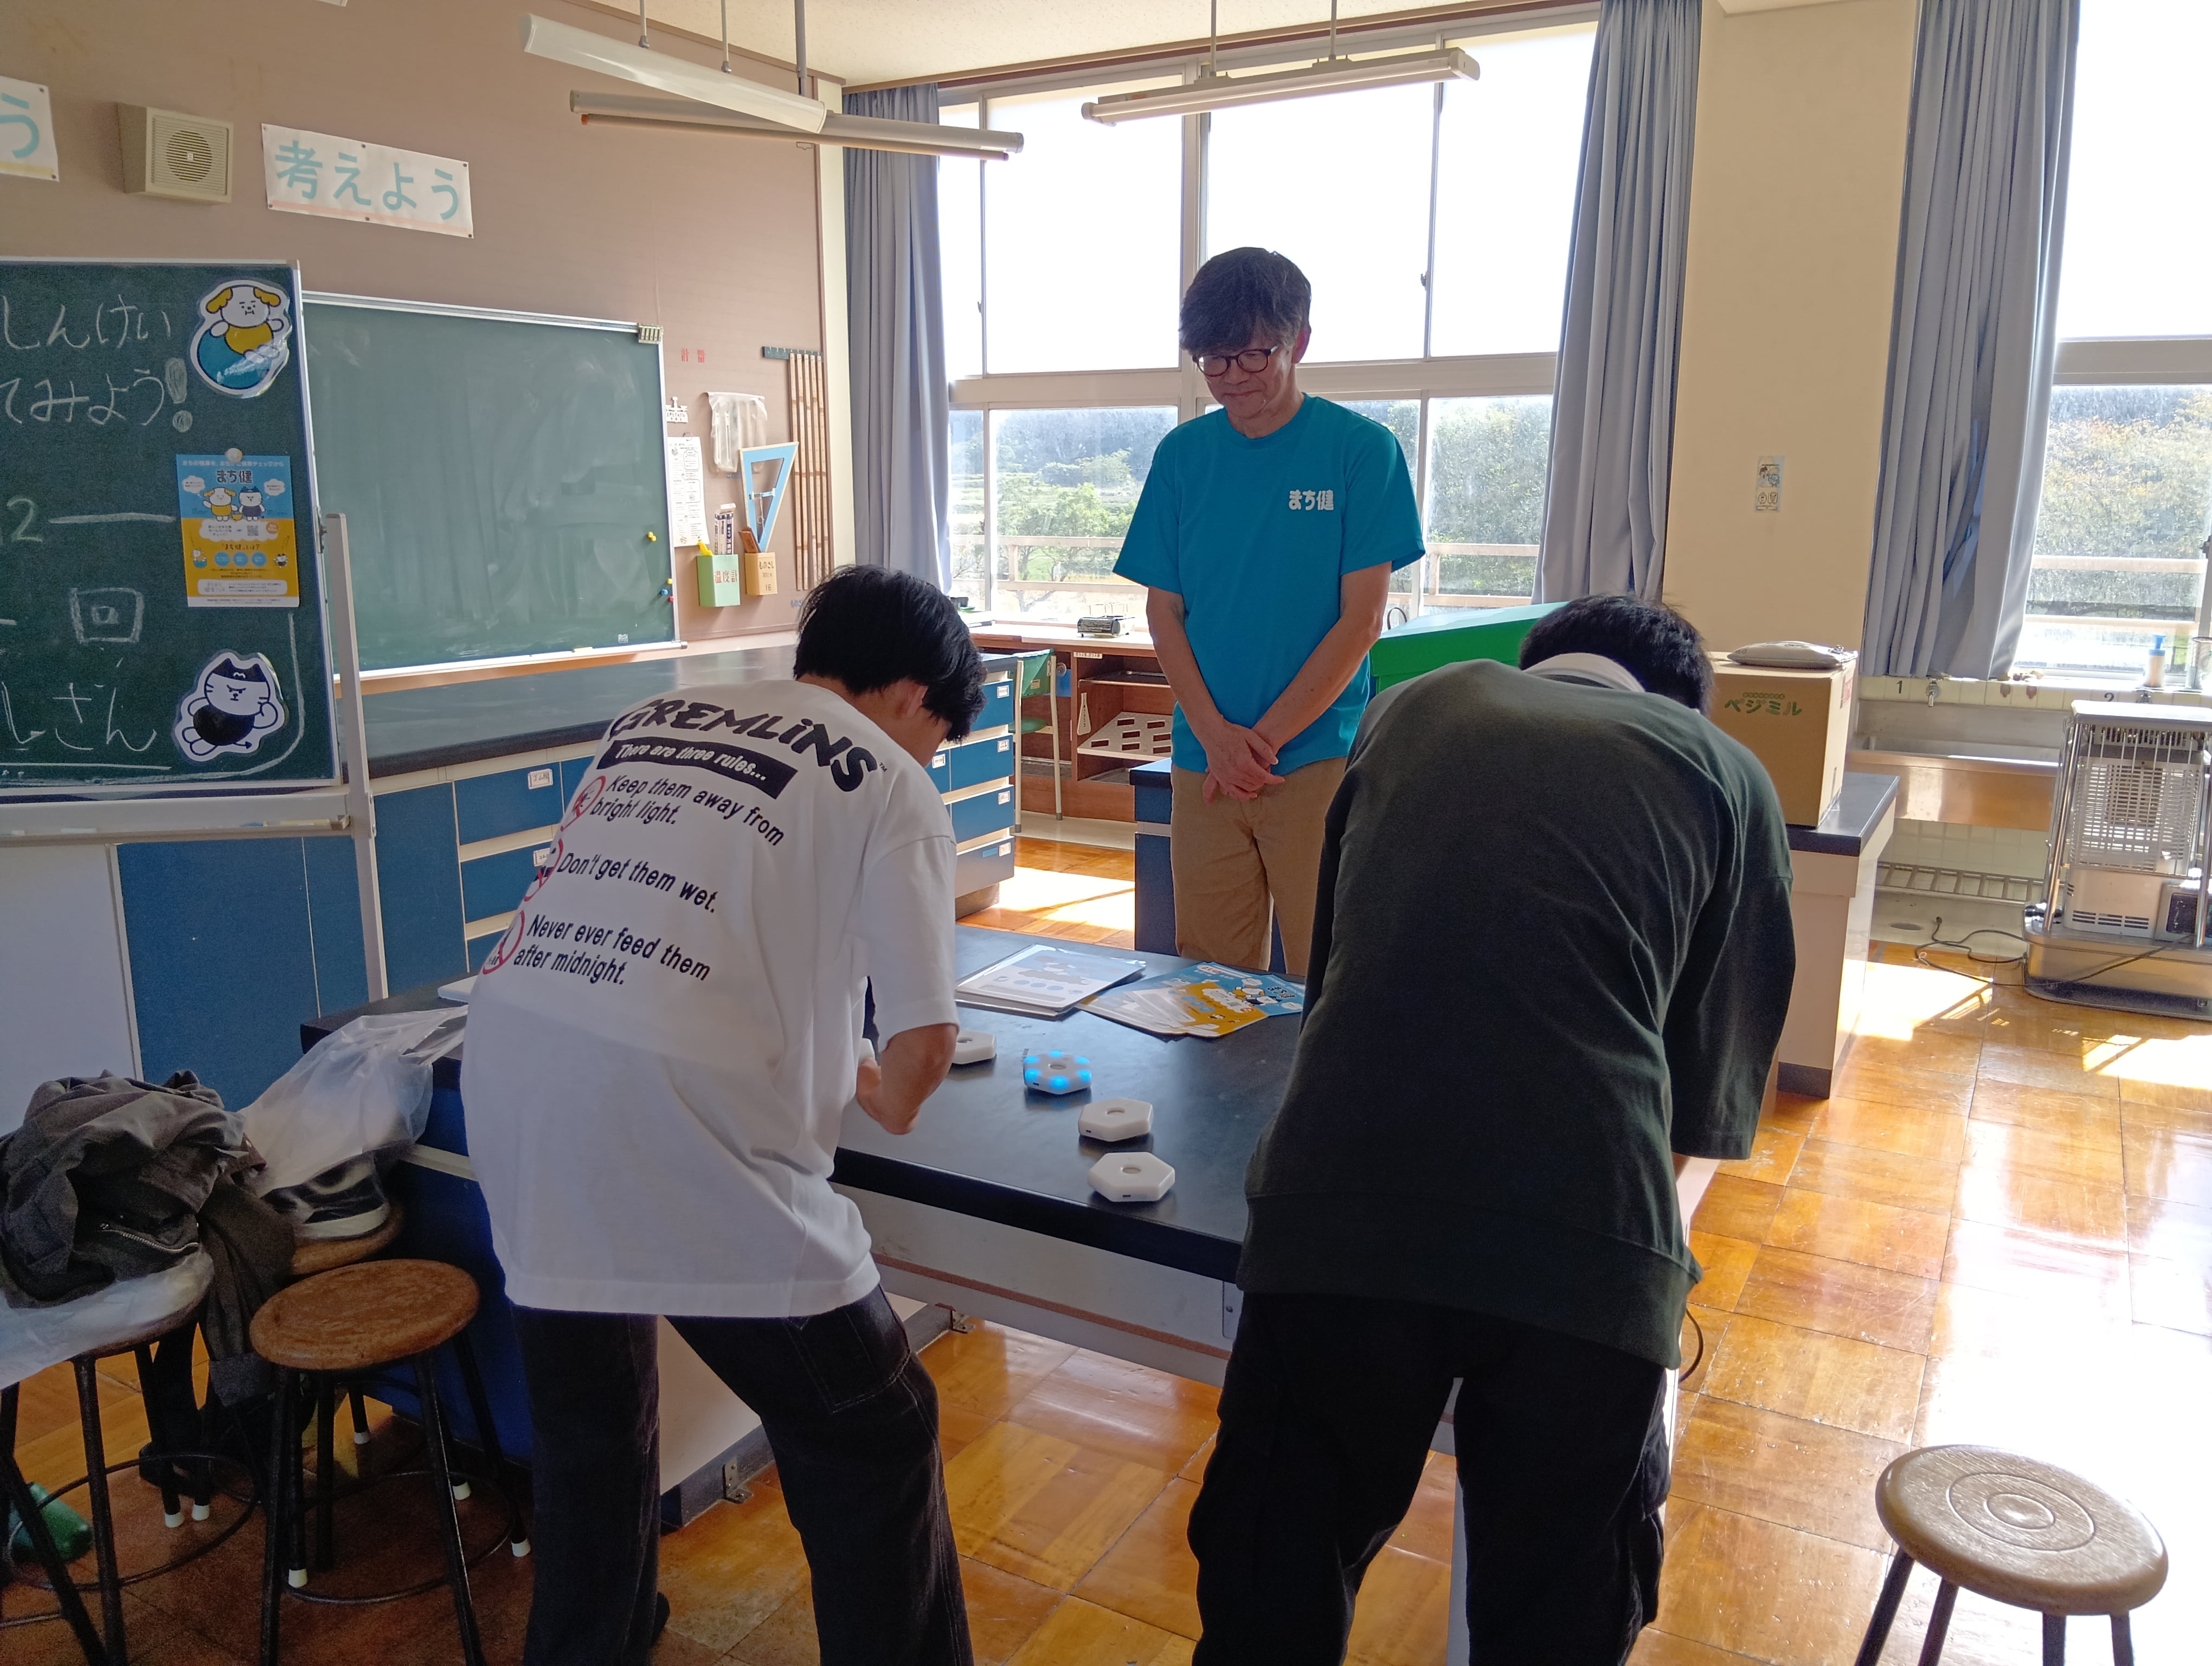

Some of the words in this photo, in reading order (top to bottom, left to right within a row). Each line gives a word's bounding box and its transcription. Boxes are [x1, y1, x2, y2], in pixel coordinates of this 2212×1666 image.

[275, 140, 459, 220] 考えよう
[3, 294, 171, 349] しんけい
[217, 469, 253, 484] まち健
[1289, 489, 1334, 510] まち健
[7, 498, 43, 542] 2
[714, 570, 738, 584] 温度計
[759, 561, 775, 569] ものさし
[1896, 680, 1902, 694] 1
[1725, 699, 1802, 716] ベジミル
[615, 744, 651, 758] There
[650, 745, 676, 757] are
[676, 747, 715, 760] three
[713, 753, 767, 781] rules...
[590, 797, 641, 822] bright
[635, 800, 681, 824] light.
[606, 775, 649, 798] Keep
[648, 778, 692, 798] them
[693, 790, 745, 820] away
[743, 806, 785, 846] from
[557, 853, 602, 875] Don't
[595, 858, 632, 880] get
[628, 860, 676, 892] them
[679, 881, 718, 913] wet.
[513, 944, 552, 969] after
[550, 950, 628, 985] midnight.
[526, 914, 574, 940] Never
[574, 924, 614, 946] ever
[612, 927, 662, 959] feed
[660, 944, 711, 981] them
